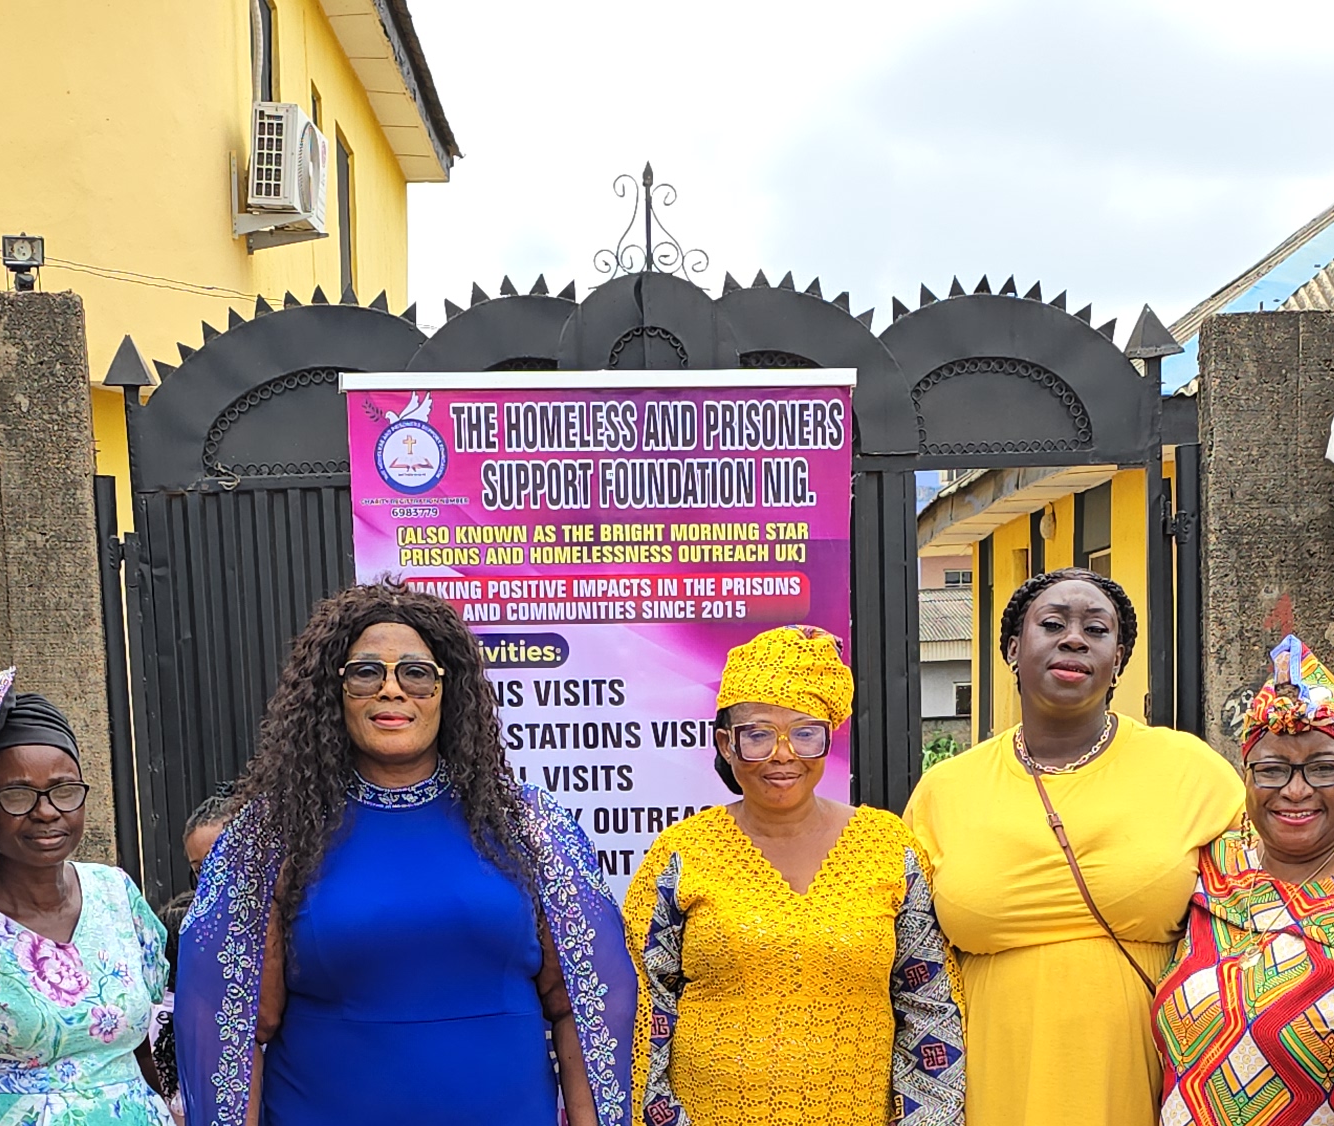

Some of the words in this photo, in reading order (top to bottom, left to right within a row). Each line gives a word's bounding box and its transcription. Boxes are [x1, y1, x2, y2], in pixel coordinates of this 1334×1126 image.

[450, 402, 498, 452] THE
[505, 401, 637, 452] HOMELESS
[643, 400, 697, 450] AND
[703, 399, 845, 450] PRISONERS
[481, 459, 593, 511] SUPPORT
[598, 458, 756, 510] FOUNDATION
[762, 457, 817, 508] NIG.
[392, 507, 439, 518] 6983779
[455, 525, 527, 544] KNOWN
[533, 525, 556, 543] AS
[562, 524, 594, 542] THE
[600, 523, 665, 542] BRIGHT
[670, 523, 760, 541] MORNING
[765, 522, 809, 541] STAR
[400, 547, 480, 566] PRISONS
[485, 547, 524, 565] AND
[530, 545, 673, 564] HOMELESSNESS
[678, 544, 770, 563] OUTREACH
[488, 579, 567, 599] POSITIVE
[573, 579, 652, 598] IMPACTS
[658, 578, 676, 597] IN
[683, 578, 716, 597] THE
[722, 577, 800, 596] PRISONS
[462, 603, 500, 622] AND
[506, 601, 636, 621] COMMUNITIES
[642, 600, 695, 620] SINCE
[701, 599, 746, 618] 2015
[478, 640, 562, 663] ivities:
[534, 679, 625, 706] VISITS
[507, 722, 641, 750] STATIONS
[543, 764, 634, 792] VISITS
